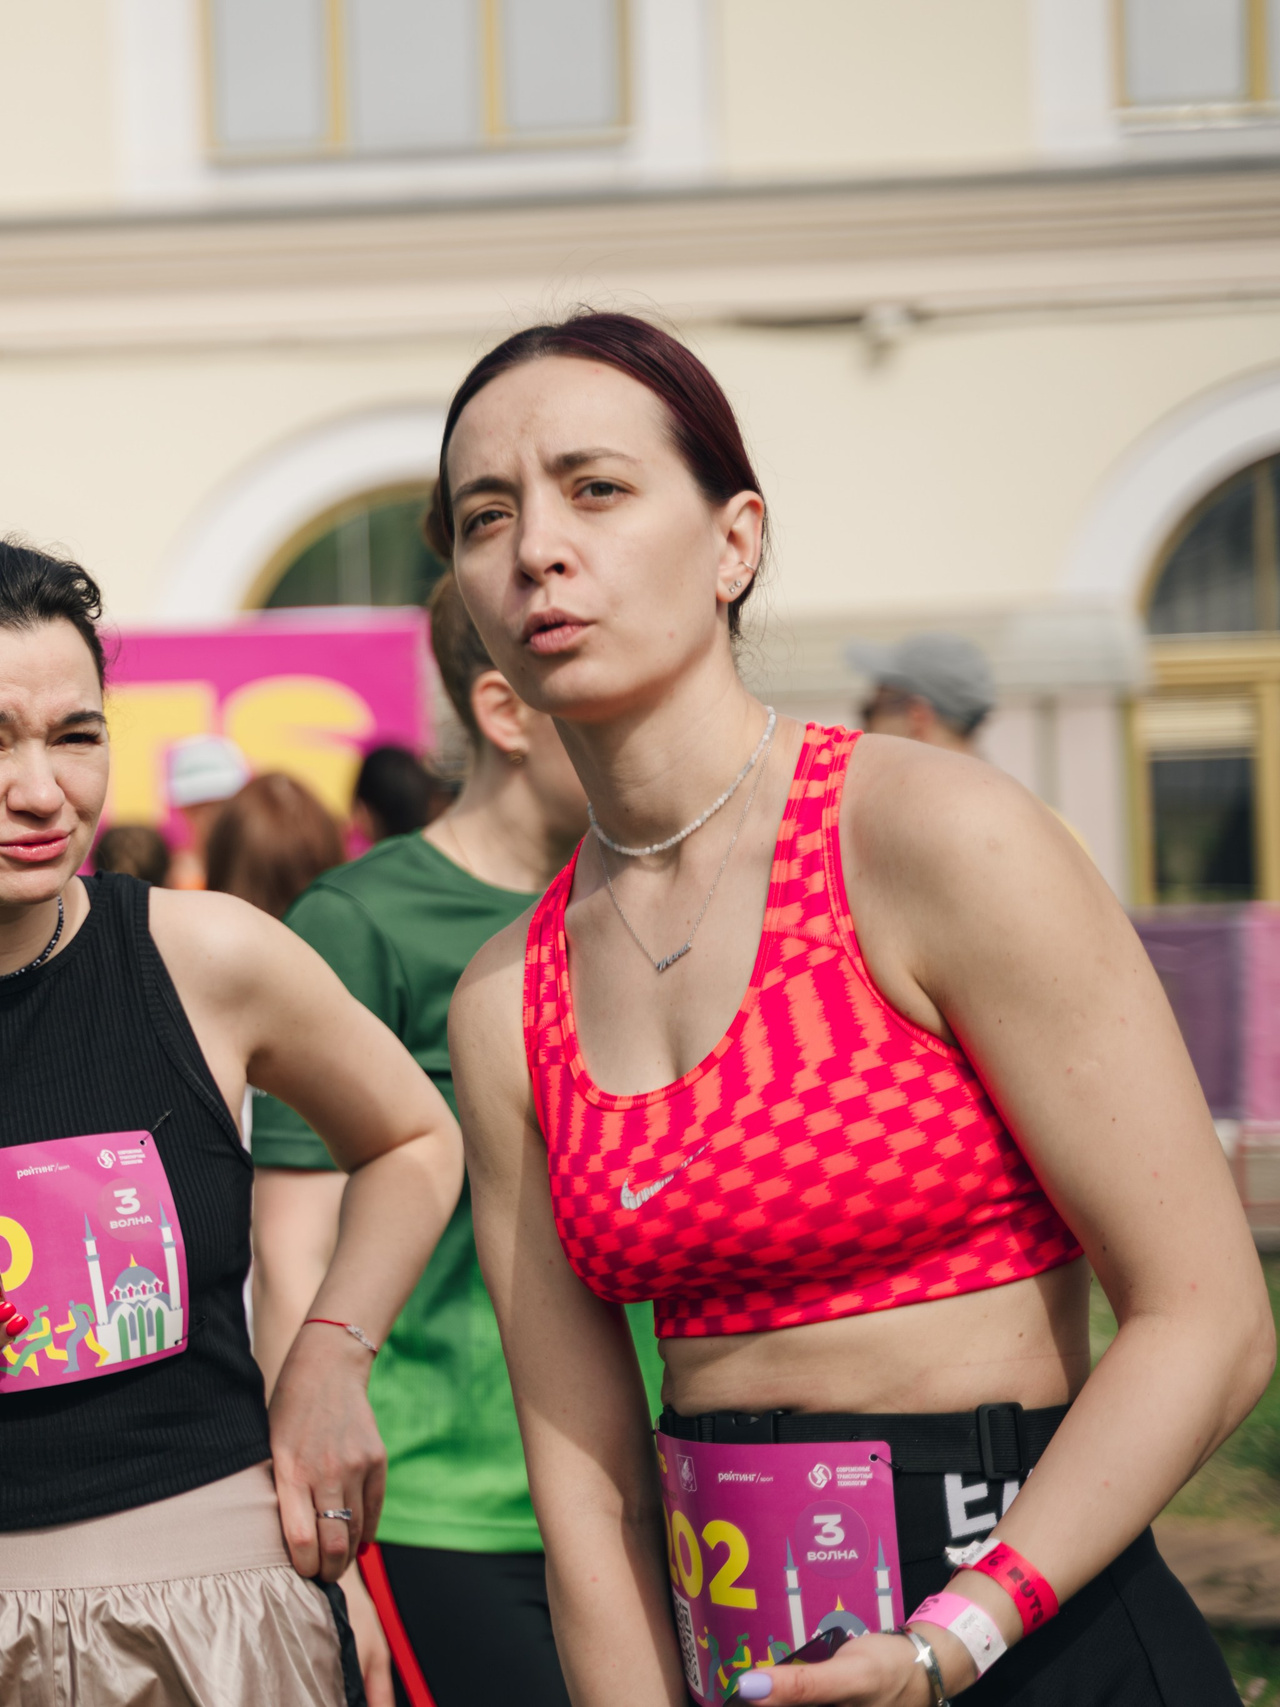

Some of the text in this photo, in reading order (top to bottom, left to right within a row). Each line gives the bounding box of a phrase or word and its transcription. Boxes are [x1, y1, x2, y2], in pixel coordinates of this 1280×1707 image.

[113, 1187, 141, 1215] 3
[109, 1215, 153, 1229] ВОЛНА
[813, 1514, 845, 1546] 3
[663, 1500, 758, 1610] 02
[807, 1550, 858, 1561] ВОЛНА
[1006, 1566, 1044, 1624] RUTS
